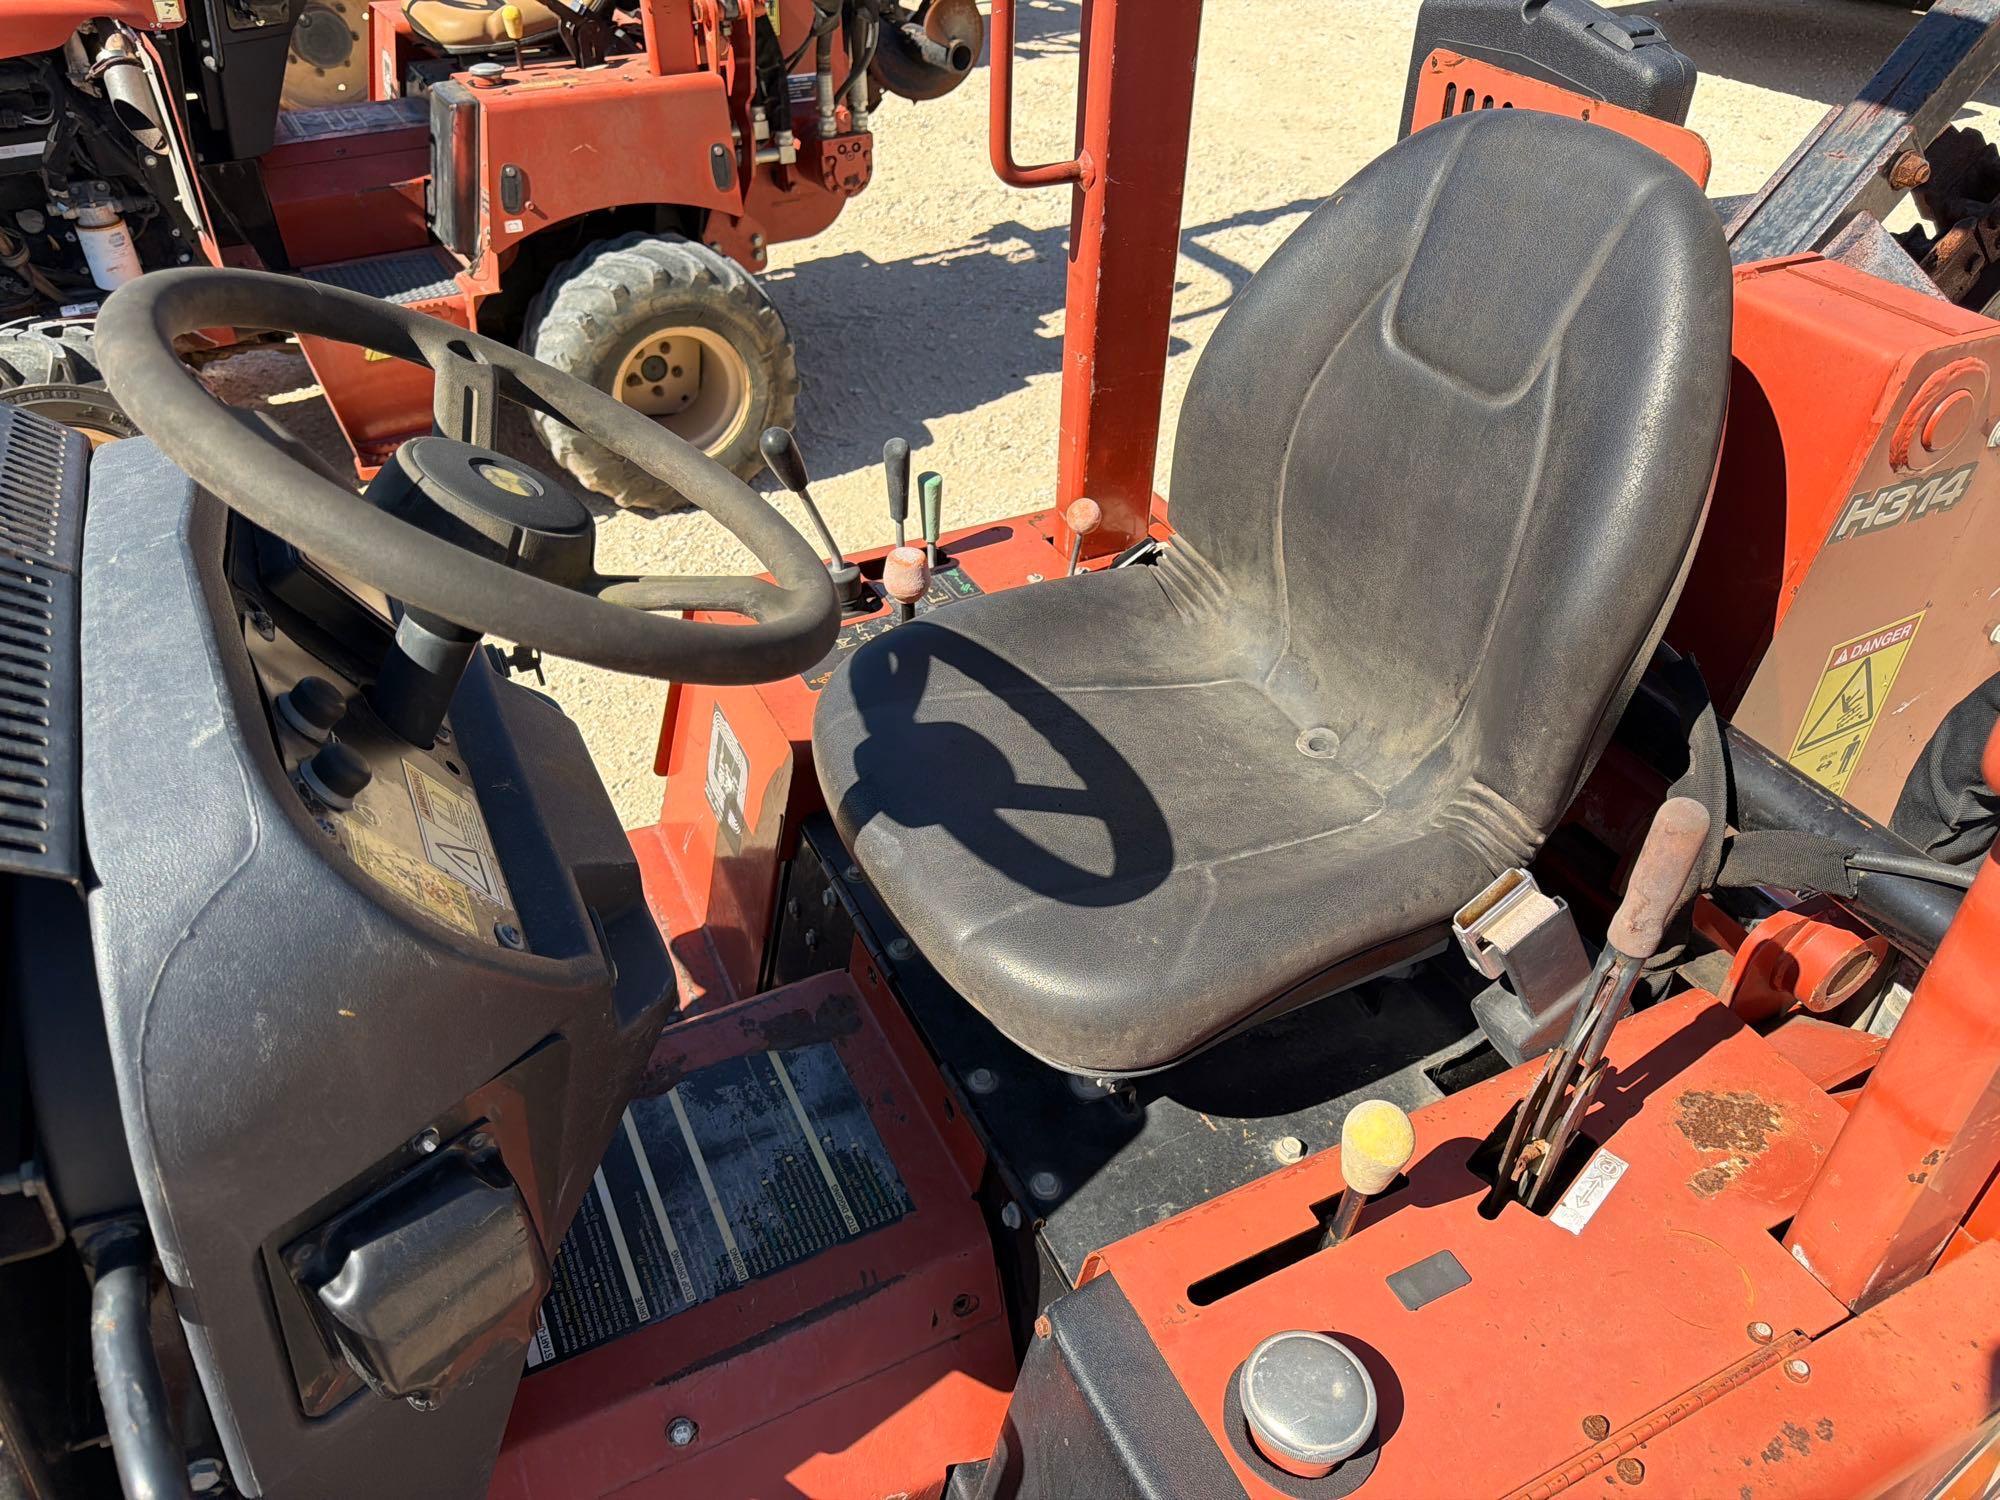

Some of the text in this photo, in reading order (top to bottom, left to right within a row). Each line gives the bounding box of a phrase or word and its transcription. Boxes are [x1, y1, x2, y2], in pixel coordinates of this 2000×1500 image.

[1835, 468, 1972, 537] H314
[1849, 623, 1913, 660] DANGER
[832, 1183, 858, 1233] STOP DIGGING
[672, 1250, 694, 1300] STOP DRIVING
[730, 1247, 747, 1279] DIGGING
[636, 1297, 648, 1319] DRIVE
